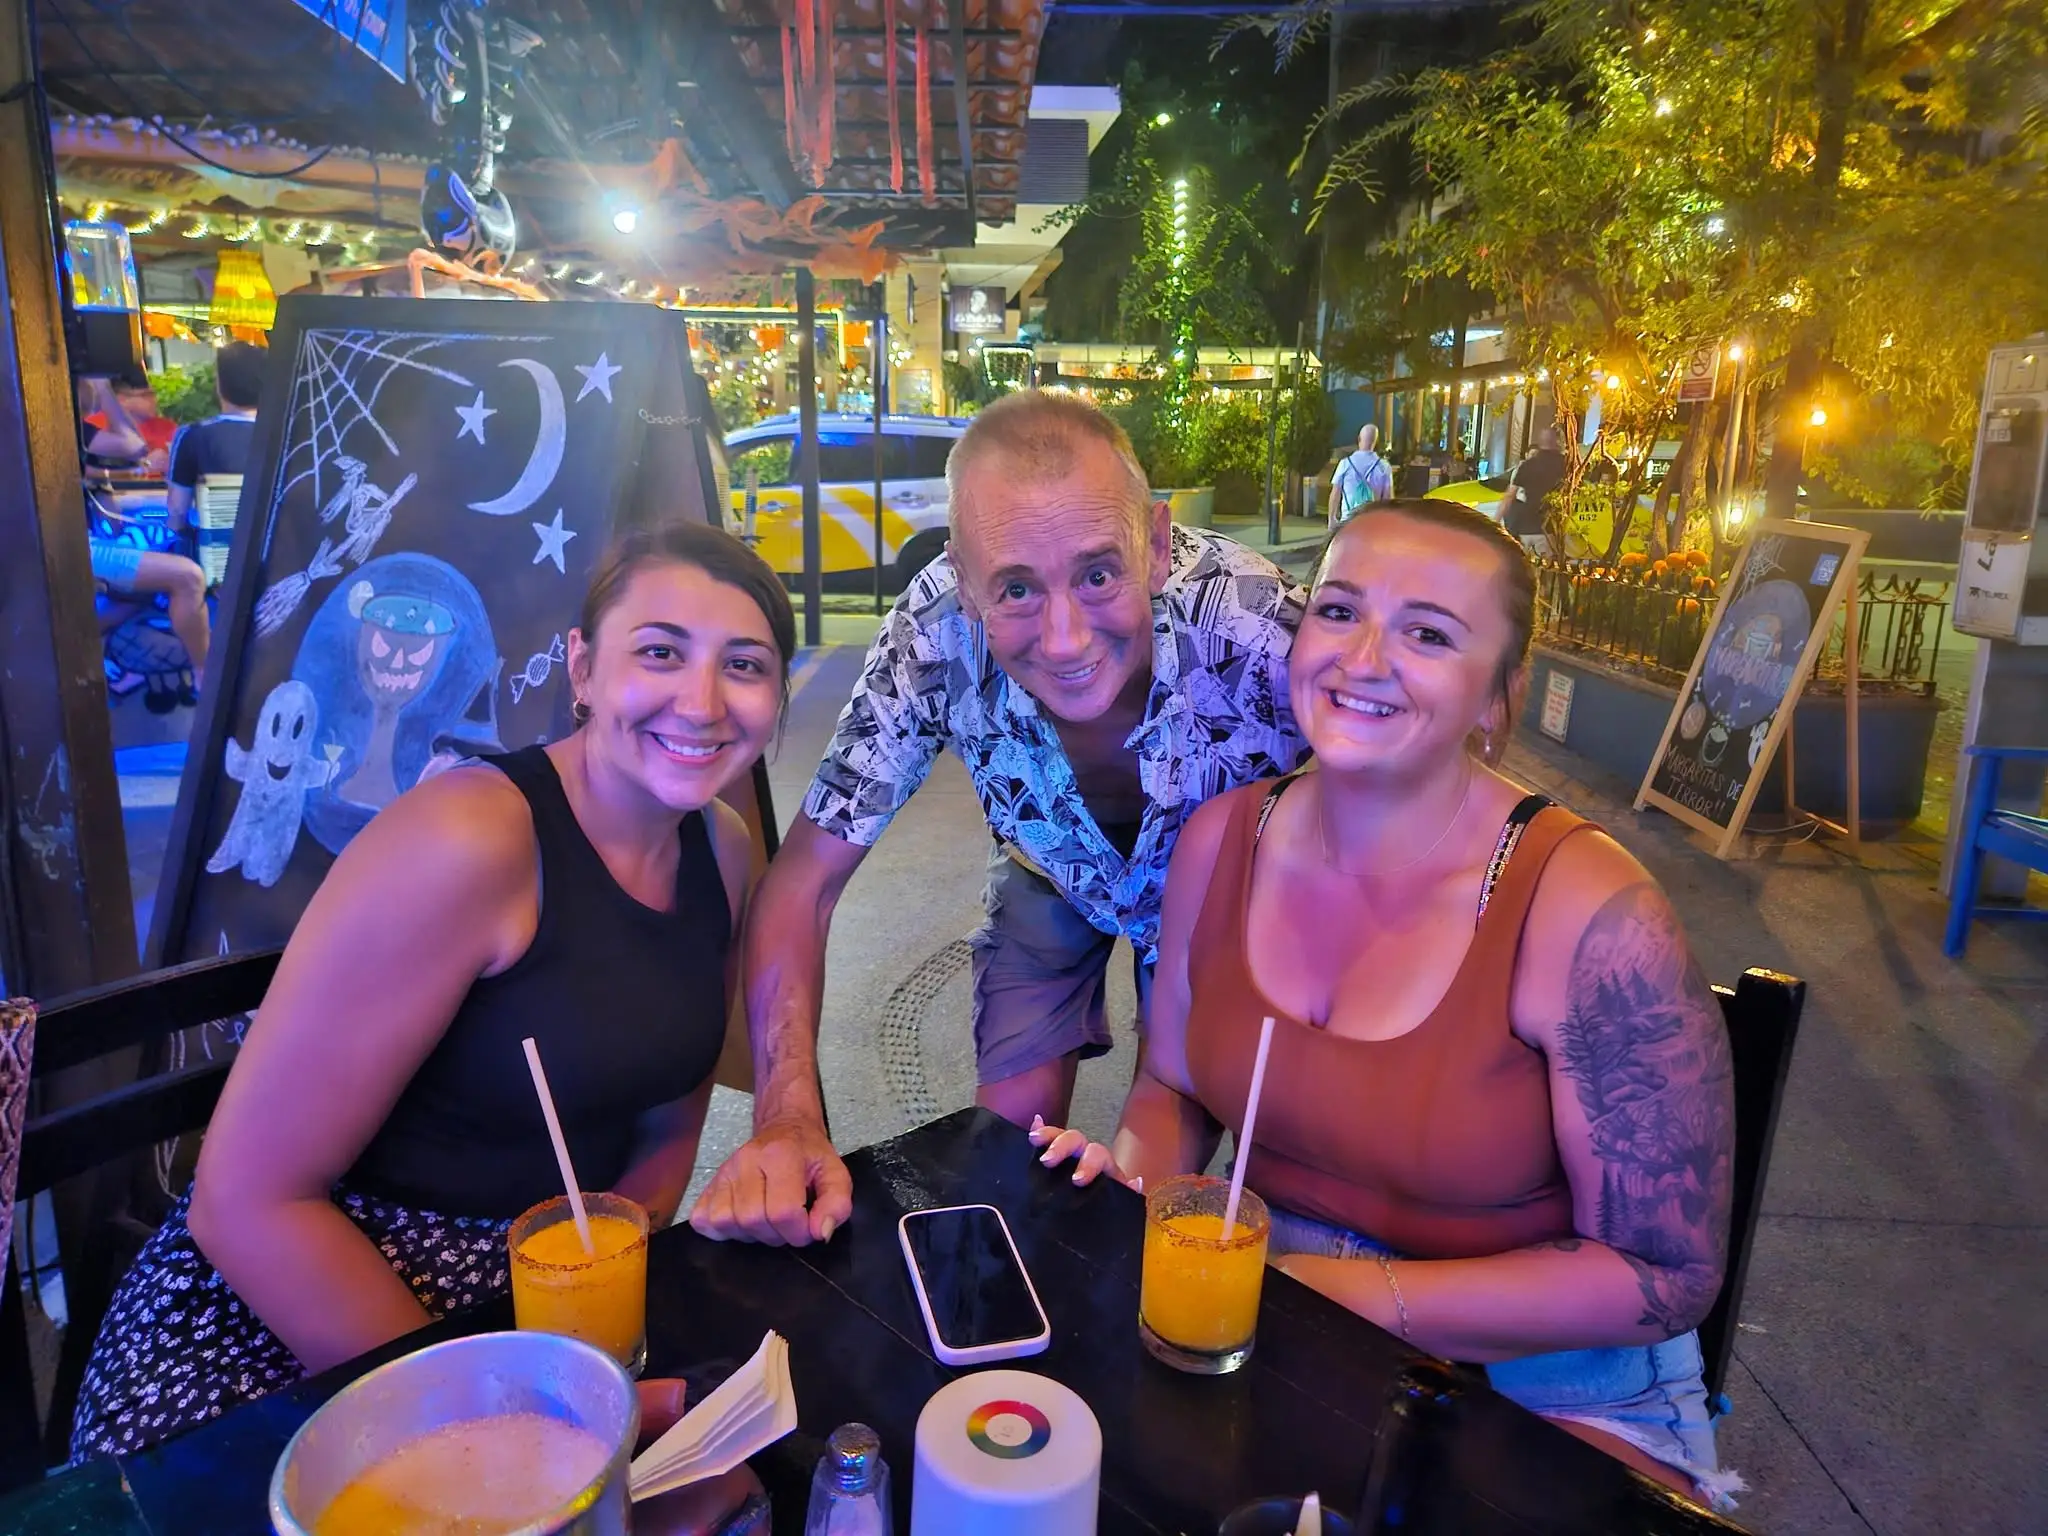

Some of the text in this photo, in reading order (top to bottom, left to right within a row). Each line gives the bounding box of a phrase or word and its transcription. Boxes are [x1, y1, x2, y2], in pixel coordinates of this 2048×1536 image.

[1661, 743, 1743, 800] MARGARITAS DE
[1666, 775, 1726, 819] TERROR!!
